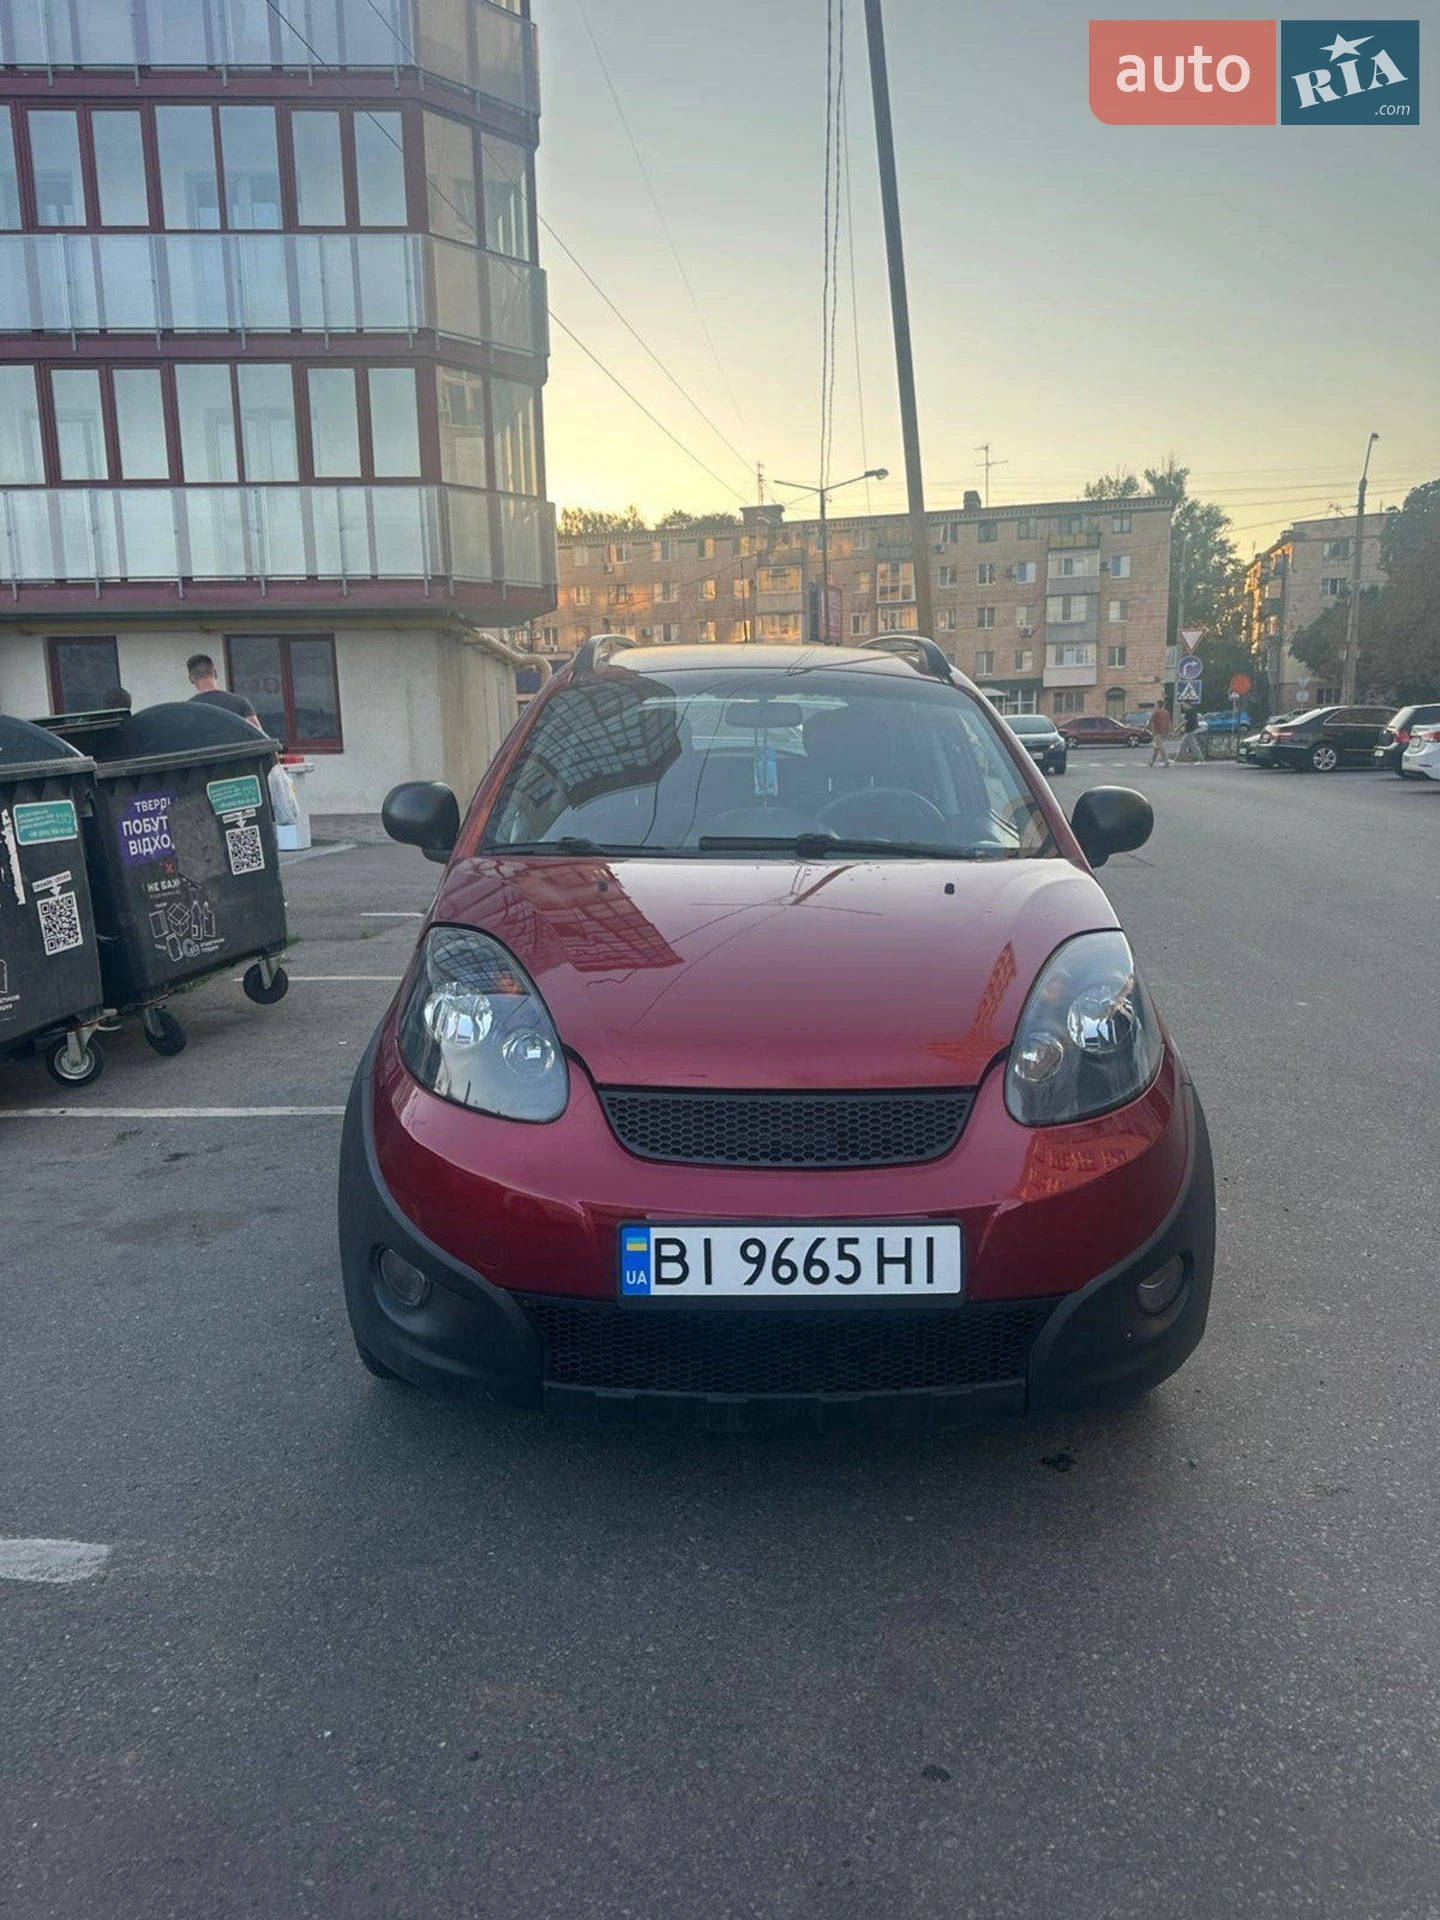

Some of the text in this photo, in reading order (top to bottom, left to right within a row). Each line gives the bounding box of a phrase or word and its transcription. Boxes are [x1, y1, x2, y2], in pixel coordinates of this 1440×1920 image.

[122, 815, 168, 837] ПОБУТ
[128, 833, 175, 856] ВІДХО
[654, 1237, 712, 1285] BI
[626, 1270, 648, 1285] UA
